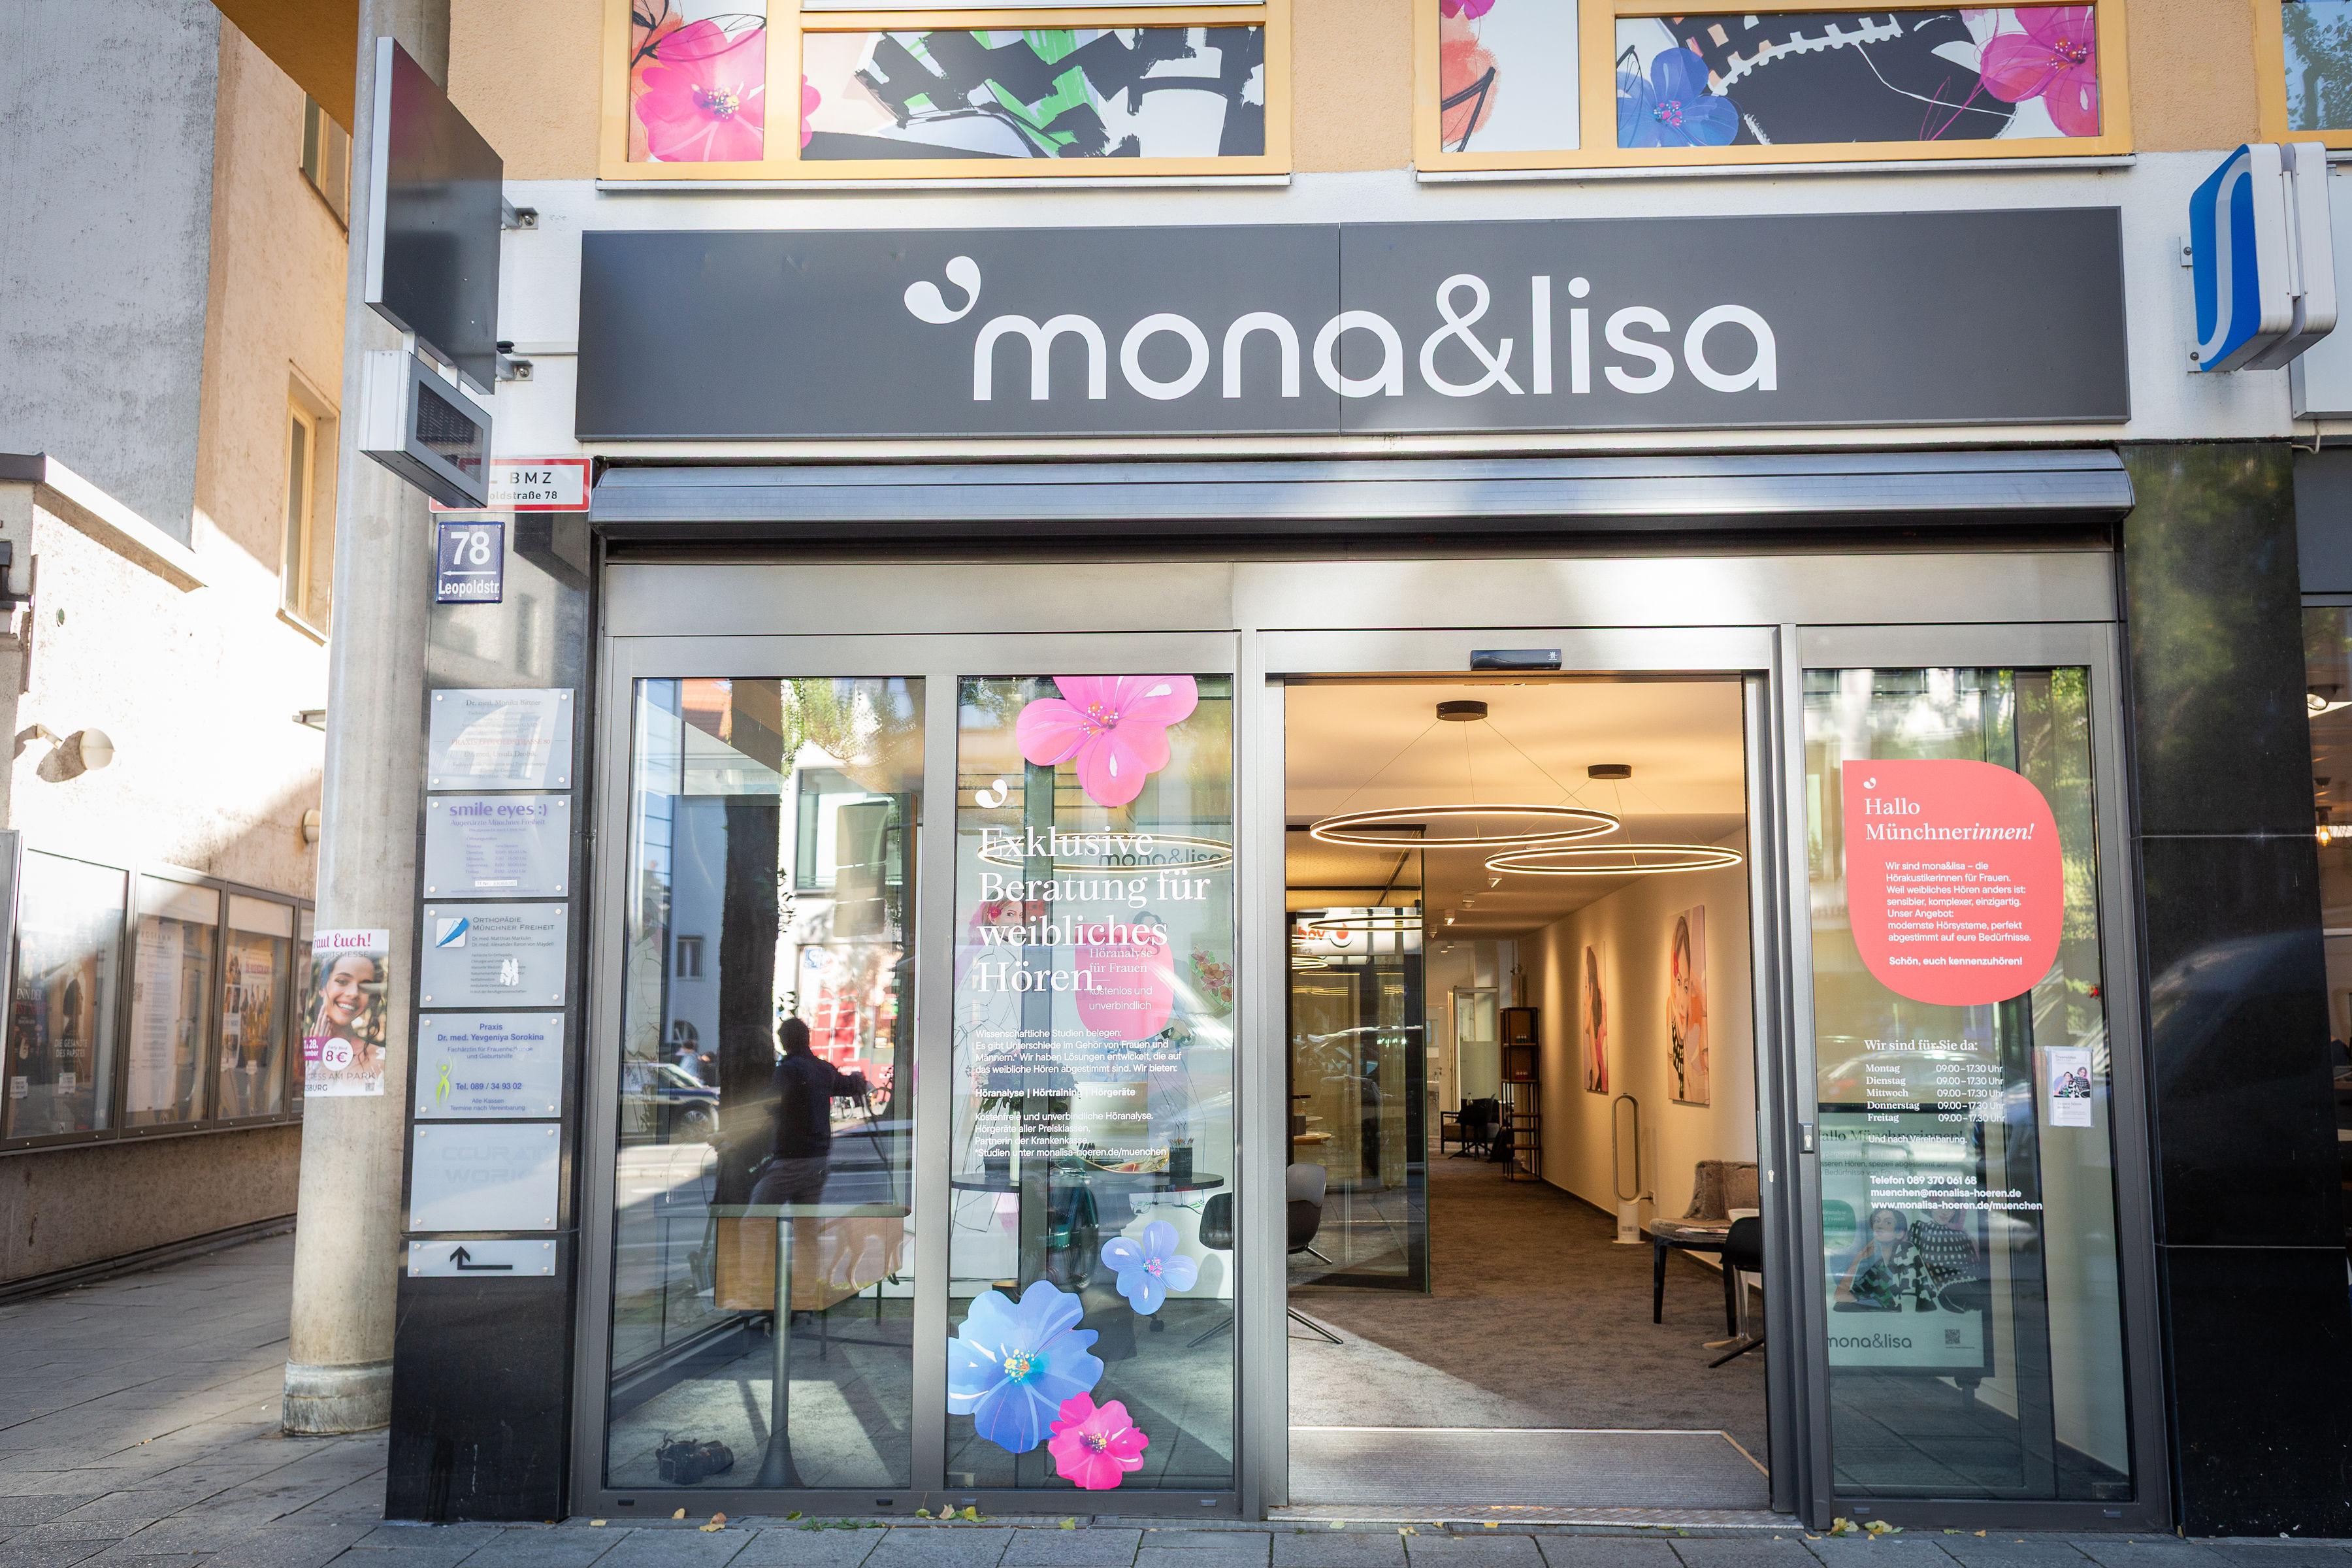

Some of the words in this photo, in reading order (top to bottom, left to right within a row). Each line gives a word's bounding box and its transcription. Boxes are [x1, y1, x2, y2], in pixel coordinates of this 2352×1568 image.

[973, 273, 1777, 400] mona&lisa
[451, 531, 490, 564] 78
[439, 580, 499, 597] Leopoldstr.
[449, 802, 493, 816] smile
[497, 805, 534, 818] eyes
[1865, 798, 1919, 815] Hallo
[1866, 823, 2034, 840] Münchnerinnen!
[979, 826, 1154, 857] Exklusive
[1886, 874, 1963, 882] Hörakustikerinnen
[1965, 874, 1977, 882] für
[1979, 874, 2011, 882] Frauen.
[979, 872, 1148, 908] Beratung
[1156, 870, 1211, 900] für
[1886, 885, 1904, 894] Weil
[1907, 885, 1952, 894] weibliches
[1953, 885, 1980, 894] Hören
[1982, 885, 2012, 894] anders
[2014, 885, 2026, 894] ist:
[1887, 897, 1926, 907] sensibler,
[1929, 897, 1974, 907] komplexer,
[1976, 897, 2021, 907] einzigartig.
[1915, 909, 1954, 919] Angebot:
[977, 915, 1168, 947] weibliches
[1936, 921, 1989, 931] Hörsysteme,
[1991, 921, 2022, 931] perfekt
[314, 936, 329, 949] raut
[334, 933, 371, 947] Euch!
[1888, 933, 1938, 943] abgestimmt
[1090, 949, 1152, 960] Höranalyse
[1889, 956, 1921, 966] Schön,
[1923, 956, 1946, 965] euch
[1948, 956, 2023, 965] kennenzuhören!
[1090, 963, 1105, 973] für
[1109, 963, 1147, 973] Frauen
[978, 961, 1103, 992] Hören.
[1089, 986, 1132, 995] kostenlos
[1135, 986, 1152, 995] und
[1089, 1001, 1152, 1010] unverbindlich
[975, 1029, 1050, 1037] Wissenschaftliche
[1052, 1029, 1083, 1037] Studien
[472, 1034, 508, 1043] Yevgeniya
[987, 1041, 1004, 1051] gibt
[1006, 1041, 1061, 1049] Unterschiede
[1864, 1040, 1886, 1051] Wir
[1889, 1040, 1916, 1051] sind
[1918, 1040, 1936, 1051] für
[1939, 1040, 1957, 1051] Sie
[1960, 1040, 1978, 1051] da:
[326, 1051, 333, 1062] 8
[336, 1052, 348, 1062] €
[1064, 1053, 1105, 1062] Lösungen
[1107, 1053, 1151, 1061] entwickelt,
[1061, 1065, 1110, 1074] abgestimmt
[1865, 1064, 1901, 1074] Montag
[1987, 1064, 2003, 1073] Uhr
[1866, 1077, 1906, 1086] Dienstag
[1988, 1077, 2004, 1085] Uhr
[975, 1089, 1024, 1098] Höranalyse
[1033, 1088, 1082, 1098] Hörtraining
[1091, 1088, 1135, 1098] Hörgeräte
[1867, 1088, 1908, 1097] Mittwoch
[1867, 1102, 1920, 1111] Donnerstag
[1042, 1112, 1103, 1120] unverbindliche
[1105, 1111, 1154, 1121] Höranalyse.
[1868, 1113, 1899, 1124] Freitag
[975, 1124, 1016, 1134] Hörgeräte
[1910, 1135, 1967, 1145] Vereinbarung.
[1013, 1149, 1034, 1157] unter
[1037, 1148, 1166, 1158] monalisa-hoeren.de/muenchen
[1870, 1176, 1905, 1184] Telefon
[1906, 1176, 1925, 1184] 089
[1927, 1176, 1944, 1184] 370
[1946, 1176, 1962, 1184] 061
[1965, 1176, 1977, 1184] 68
[1871, 1189, 2021, 1198] muenchen@monalisa-hoeren.de
[1871, 1201, 2043, 1211] www.monalisa-hoeren.de/muenchen
